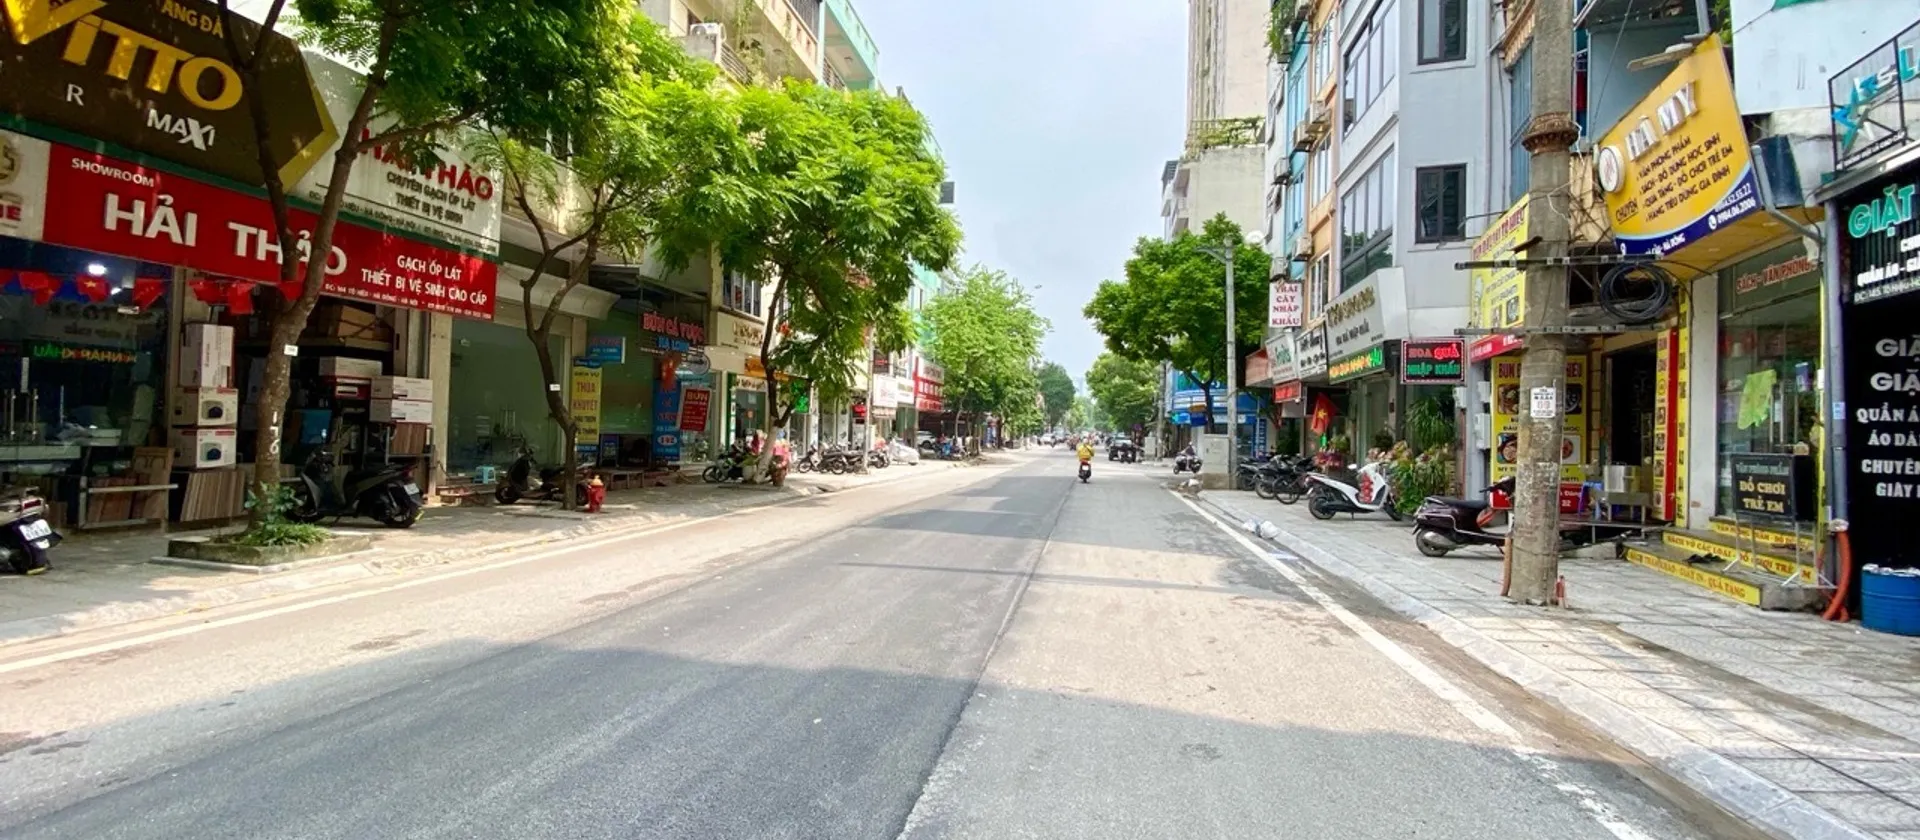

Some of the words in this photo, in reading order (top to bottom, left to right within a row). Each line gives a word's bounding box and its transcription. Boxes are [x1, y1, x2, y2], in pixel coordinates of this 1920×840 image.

[2, 0, 243, 110] VITTO
[147, 109, 216, 151] MAXI
[71, 157, 155, 187] SHOWROOM
[1849, 183, 1915, 238] GIẶT
[104, 193, 197, 247] HẢI
[228, 222, 347, 275] THẢO
[397, 255, 427, 273] GẠCH
[444, 266, 463, 281] LÁT
[361, 268, 392, 287] THIẾT
[395, 276, 406, 292] BỊ
[409, 278, 422, 296] VỆ
[424, 282, 446, 298] SINH
[448, 287, 467, 302] CAO
[1276, 295, 1295, 303] CÂY
[1739, 476, 1755, 492] ĐỒ
[1742, 495, 1765, 511] TRẺ
[1766, 501, 1785, 513] EM
